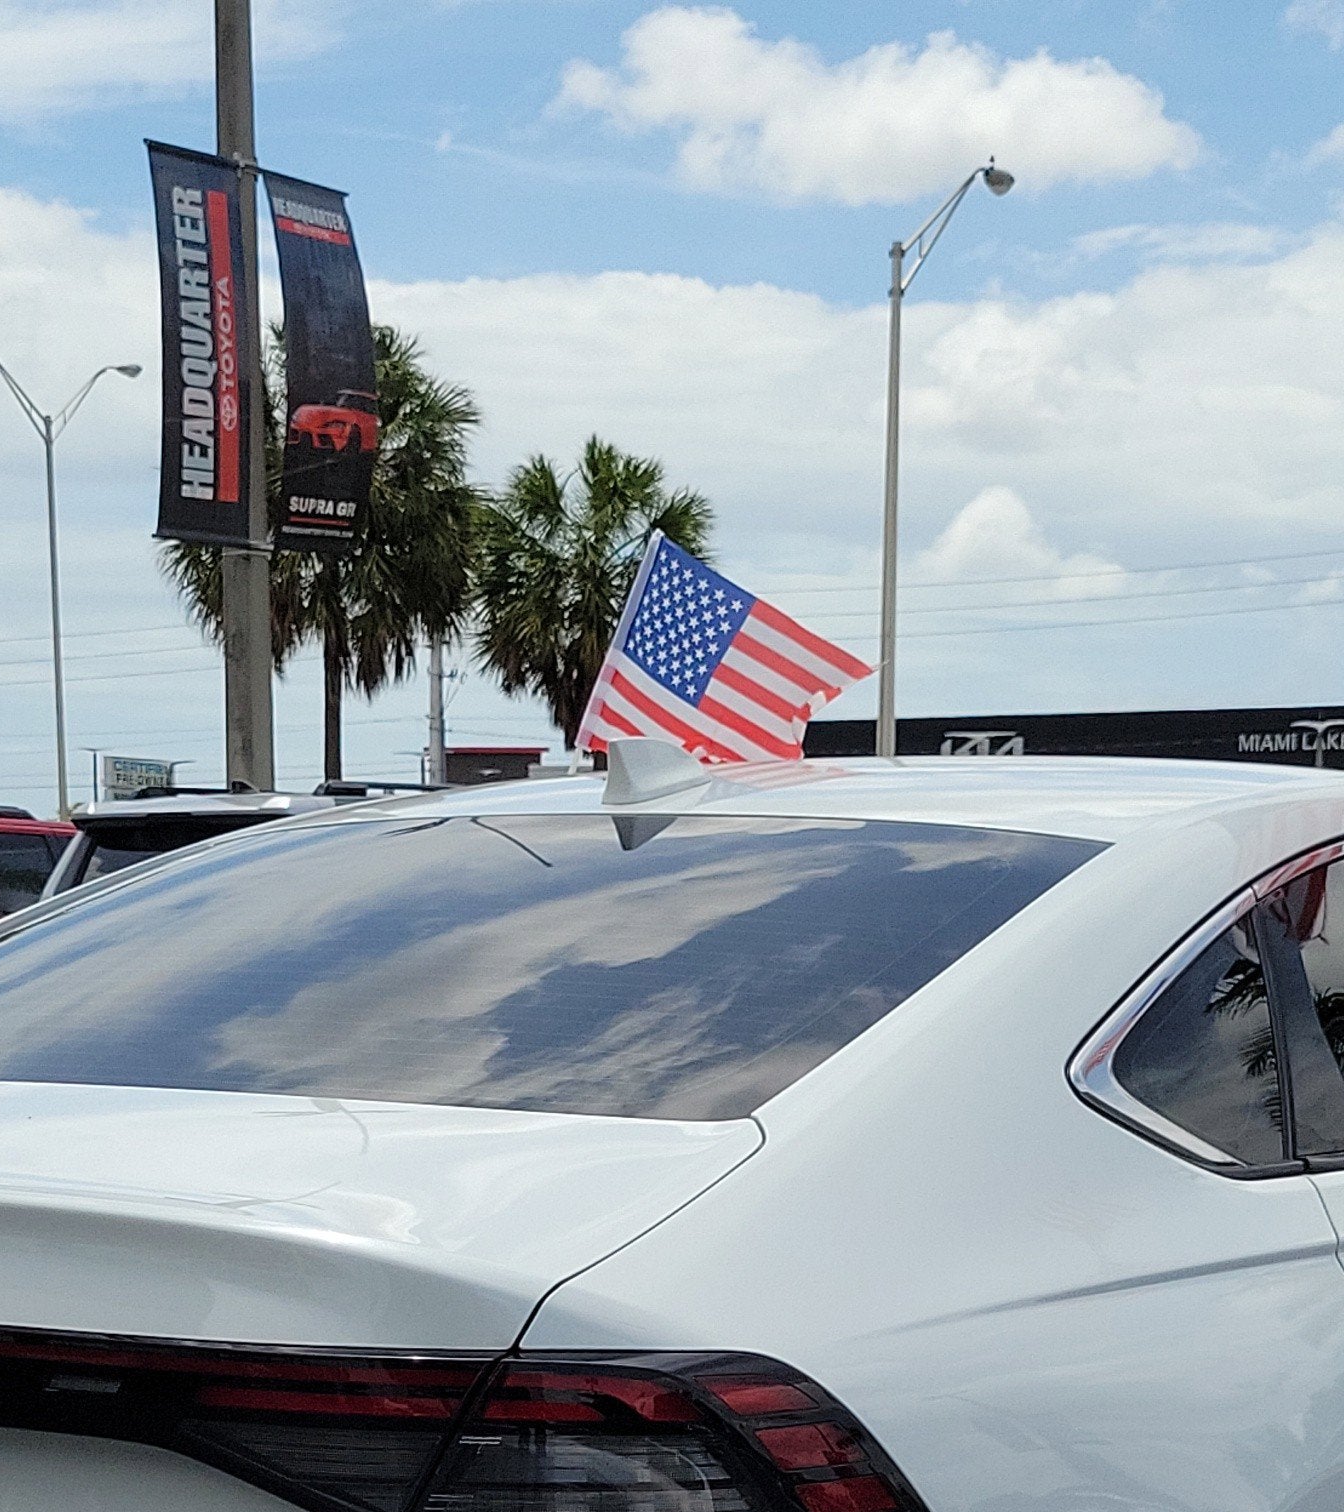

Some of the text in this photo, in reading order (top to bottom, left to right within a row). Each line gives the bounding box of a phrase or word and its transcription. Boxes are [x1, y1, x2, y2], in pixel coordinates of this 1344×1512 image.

[173, 186, 217, 501] HEADQUARTER
[215, 276, 236, 391] TOYOTA
[288, 495, 334, 516] SUPRA
[1237, 732, 1297, 753] MIAMI
